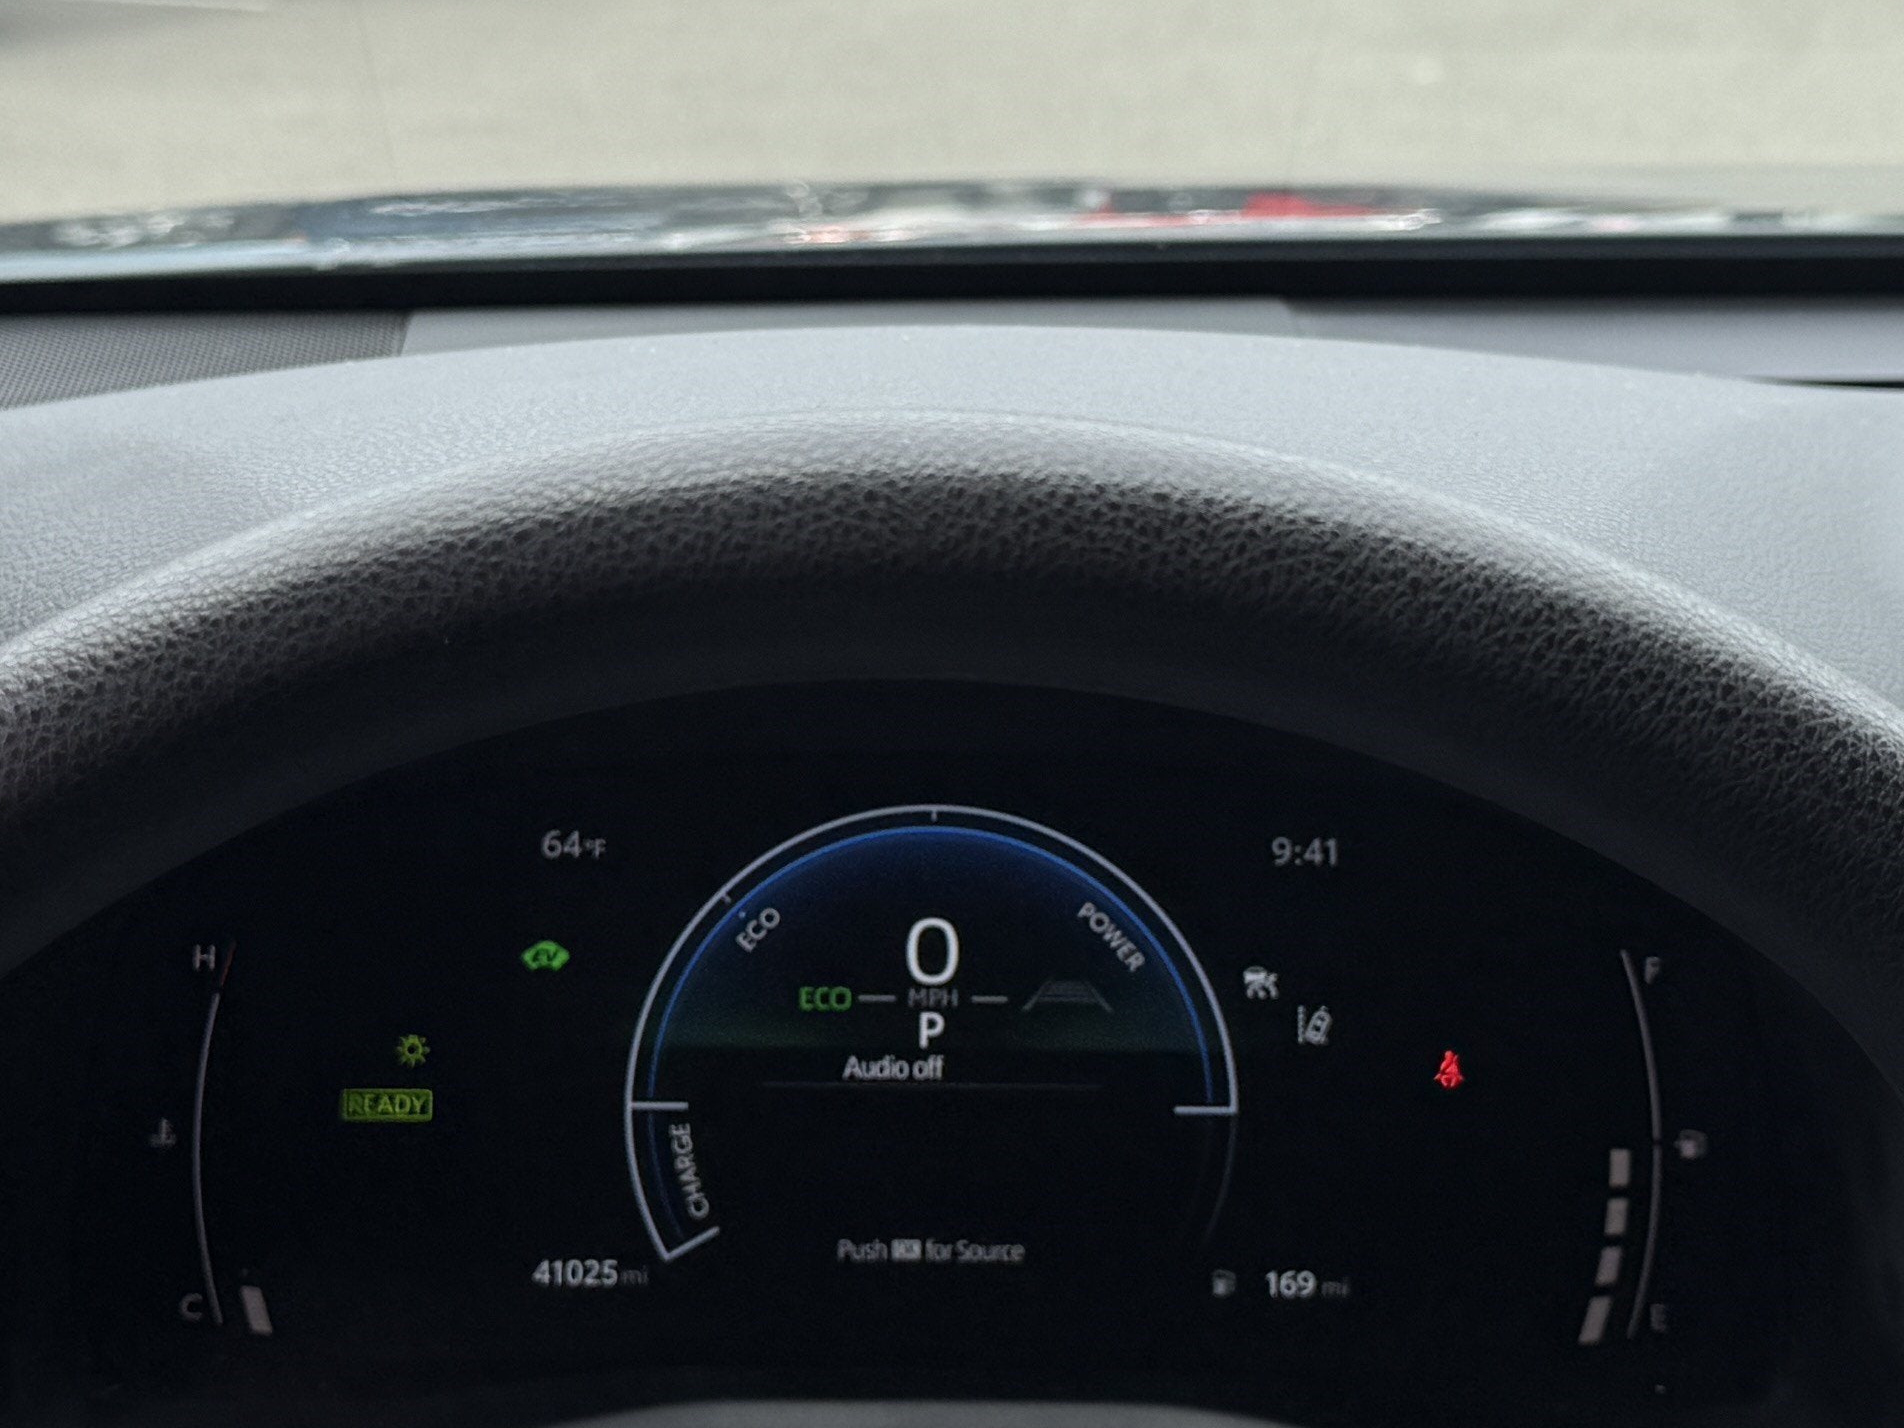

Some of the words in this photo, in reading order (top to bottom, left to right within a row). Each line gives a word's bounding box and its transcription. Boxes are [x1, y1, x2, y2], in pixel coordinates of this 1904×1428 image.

[1271, 836, 1338, 867] 9:41
[736, 907, 782, 953] ECO
[1076, 902, 1147, 973] POWER
[193, 944, 216, 971] H
[905, 917, 960, 986] 0
[799, 986, 852, 1011] ECO
[908, 988, 959, 1008] MPH
[919, 1011, 946, 1049] P
[842, 1055, 910, 1080] Audio
[912, 1054, 945, 1080] off
[348, 1093, 428, 1116] READY
[670, 1123, 711, 1219] CHARGE
[837, 1238, 889, 1262] Push
[925, 1238, 953, 1261] for
[956, 1239, 1026, 1262] Source
[531, 1259, 618, 1288] 41025
[1265, 1270, 1317, 1299] 169
